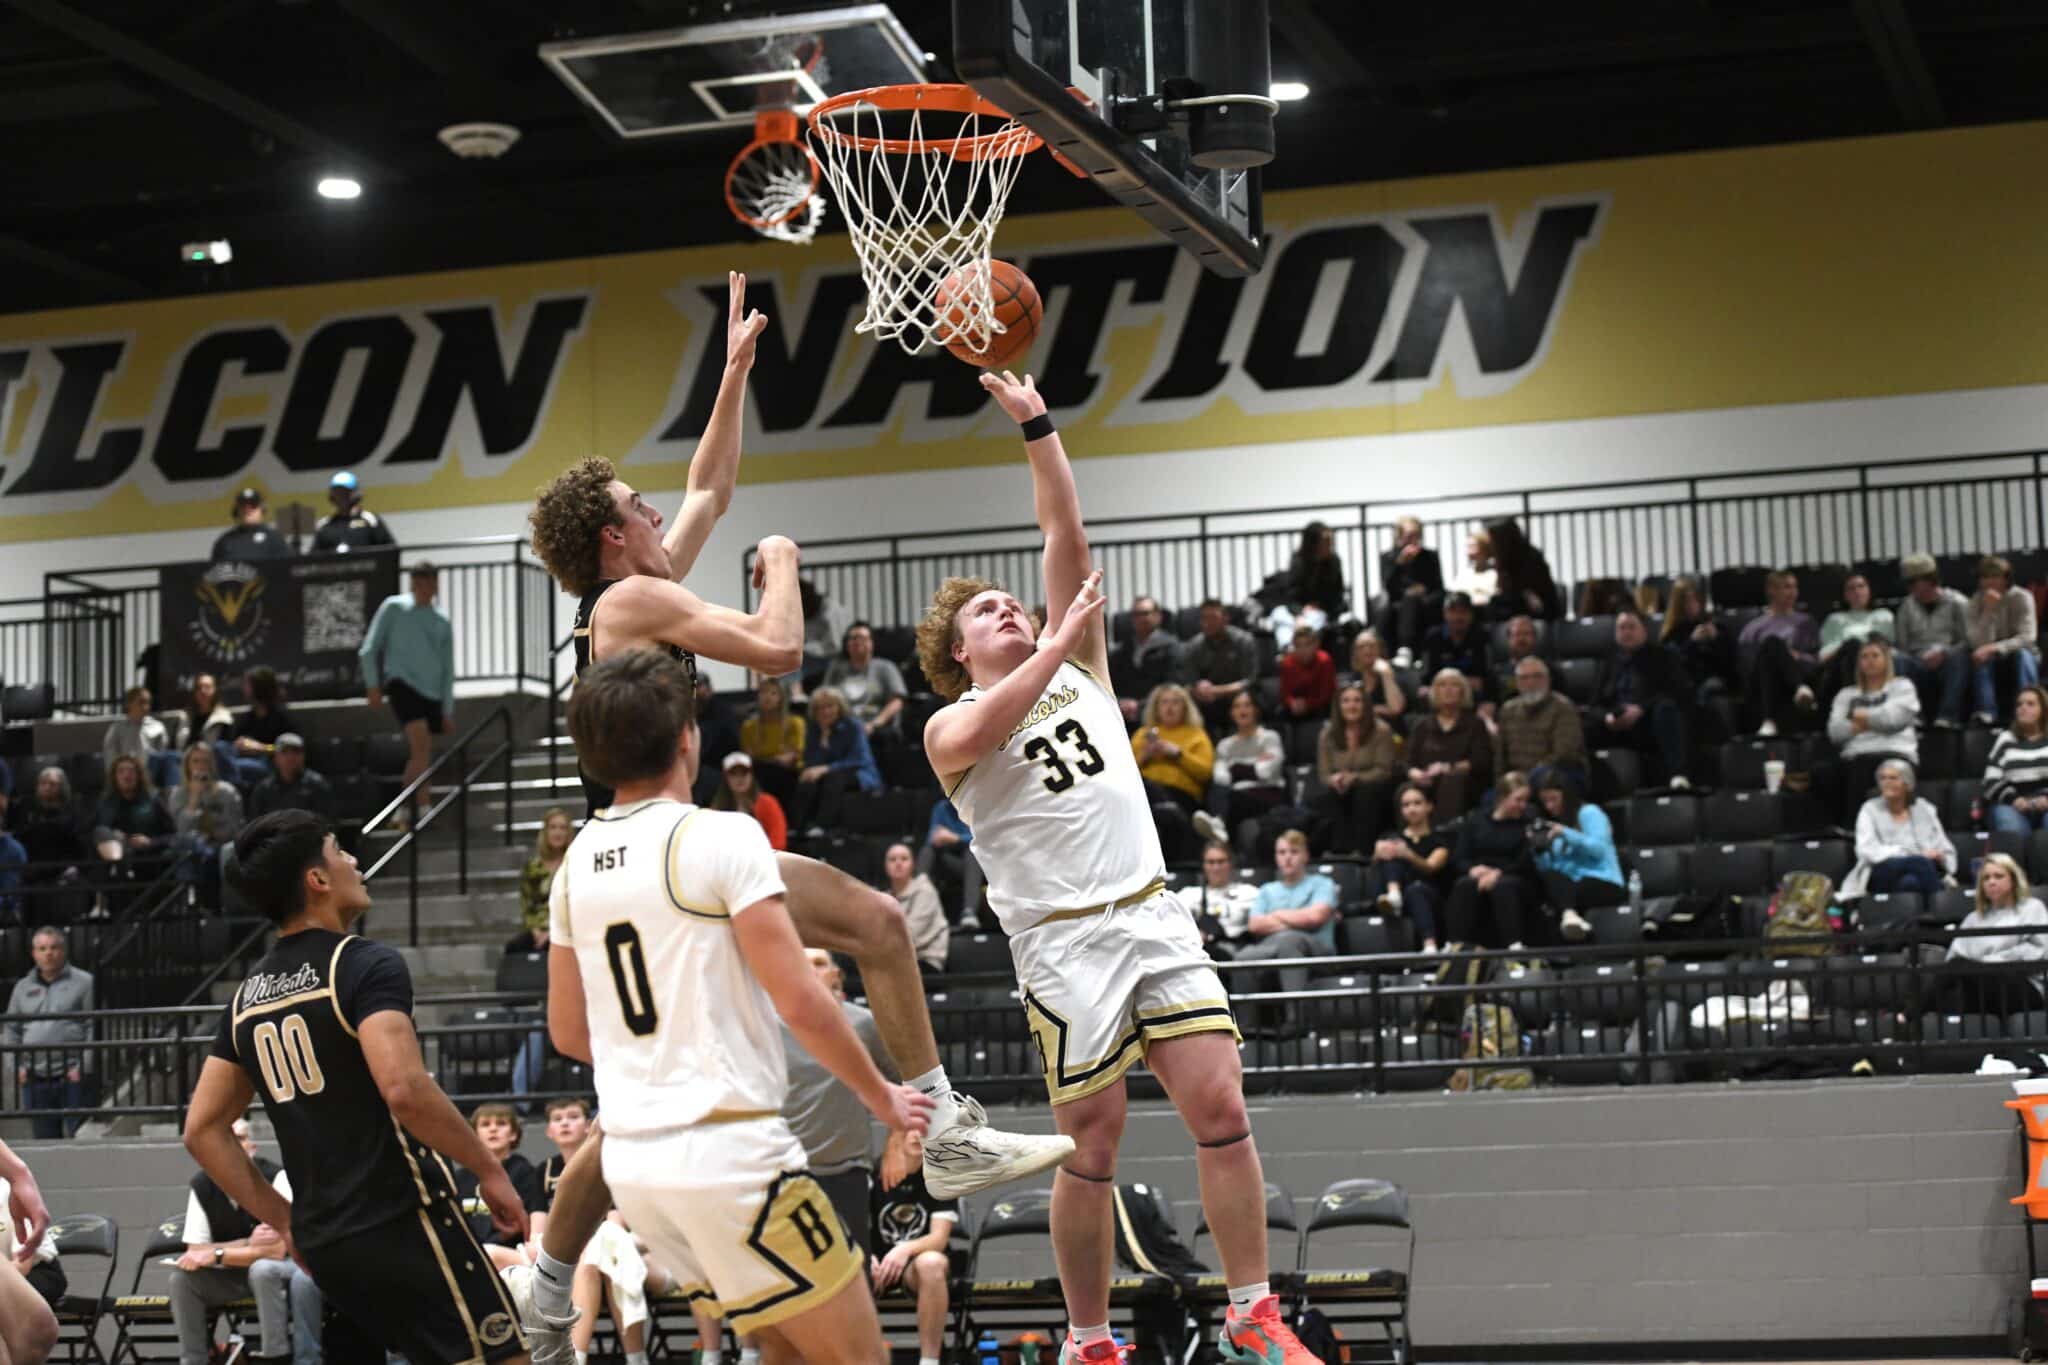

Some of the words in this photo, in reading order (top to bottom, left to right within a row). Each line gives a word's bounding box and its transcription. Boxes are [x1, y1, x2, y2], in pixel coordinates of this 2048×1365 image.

[0, 295, 590, 497] LCON
[657, 201, 1601, 442] NATION
[1023, 717, 1105, 794] 33
[593, 846, 628, 873] HST
[242, 962, 320, 1010] Wildcats
[604, 920, 659, 1037] 0
[253, 1013, 325, 1104] 00
[787, 1198, 835, 1262] B
